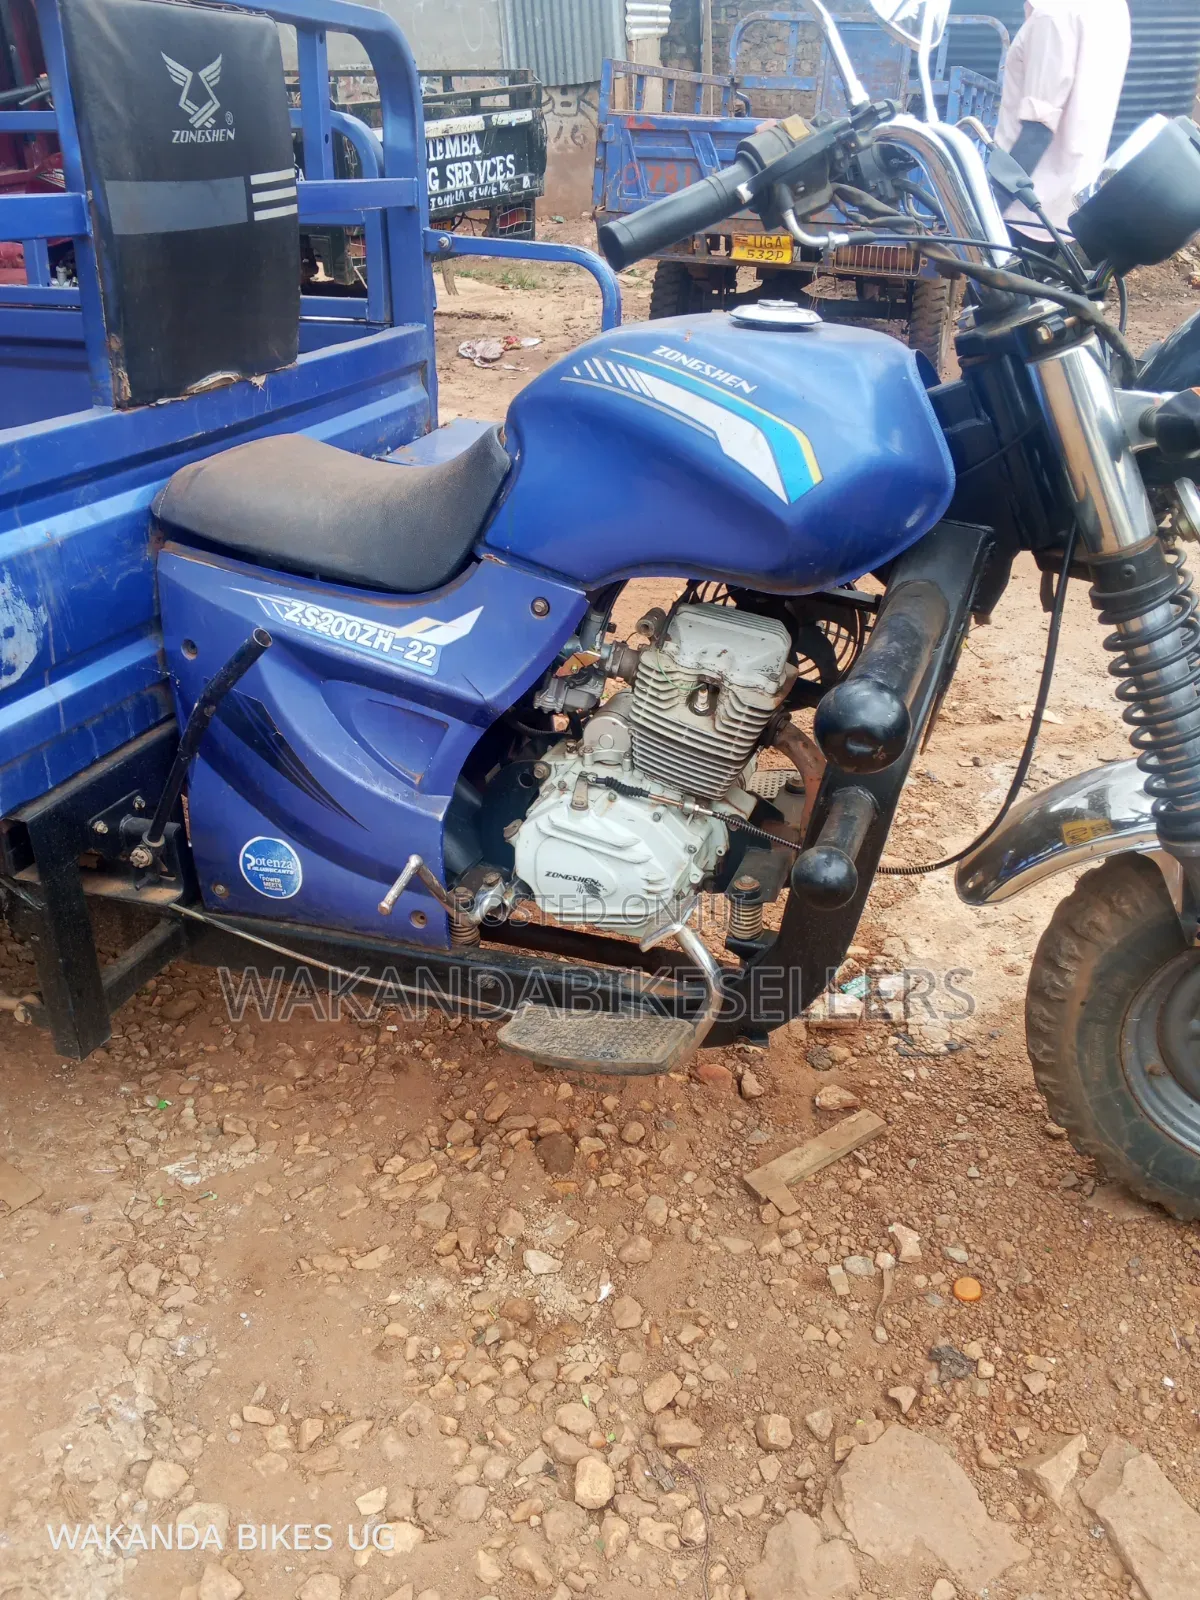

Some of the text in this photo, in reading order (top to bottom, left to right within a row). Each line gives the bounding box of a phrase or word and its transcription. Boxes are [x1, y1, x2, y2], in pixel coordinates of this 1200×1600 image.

[171, 128, 236, 144] ZONGSHEN
[425, 131, 482, 162] TEMBA
[426, 166, 439, 194] G
[754, 235, 783, 248] UGA
[747, 249, 784, 261] 532P
[652, 345, 758, 394] ZONGSHEN
[284, 600, 437, 667] ZS200ZH-22
[245, 853, 293, 871] Potenza
[544, 871, 602, 886] ZONGSHEN
